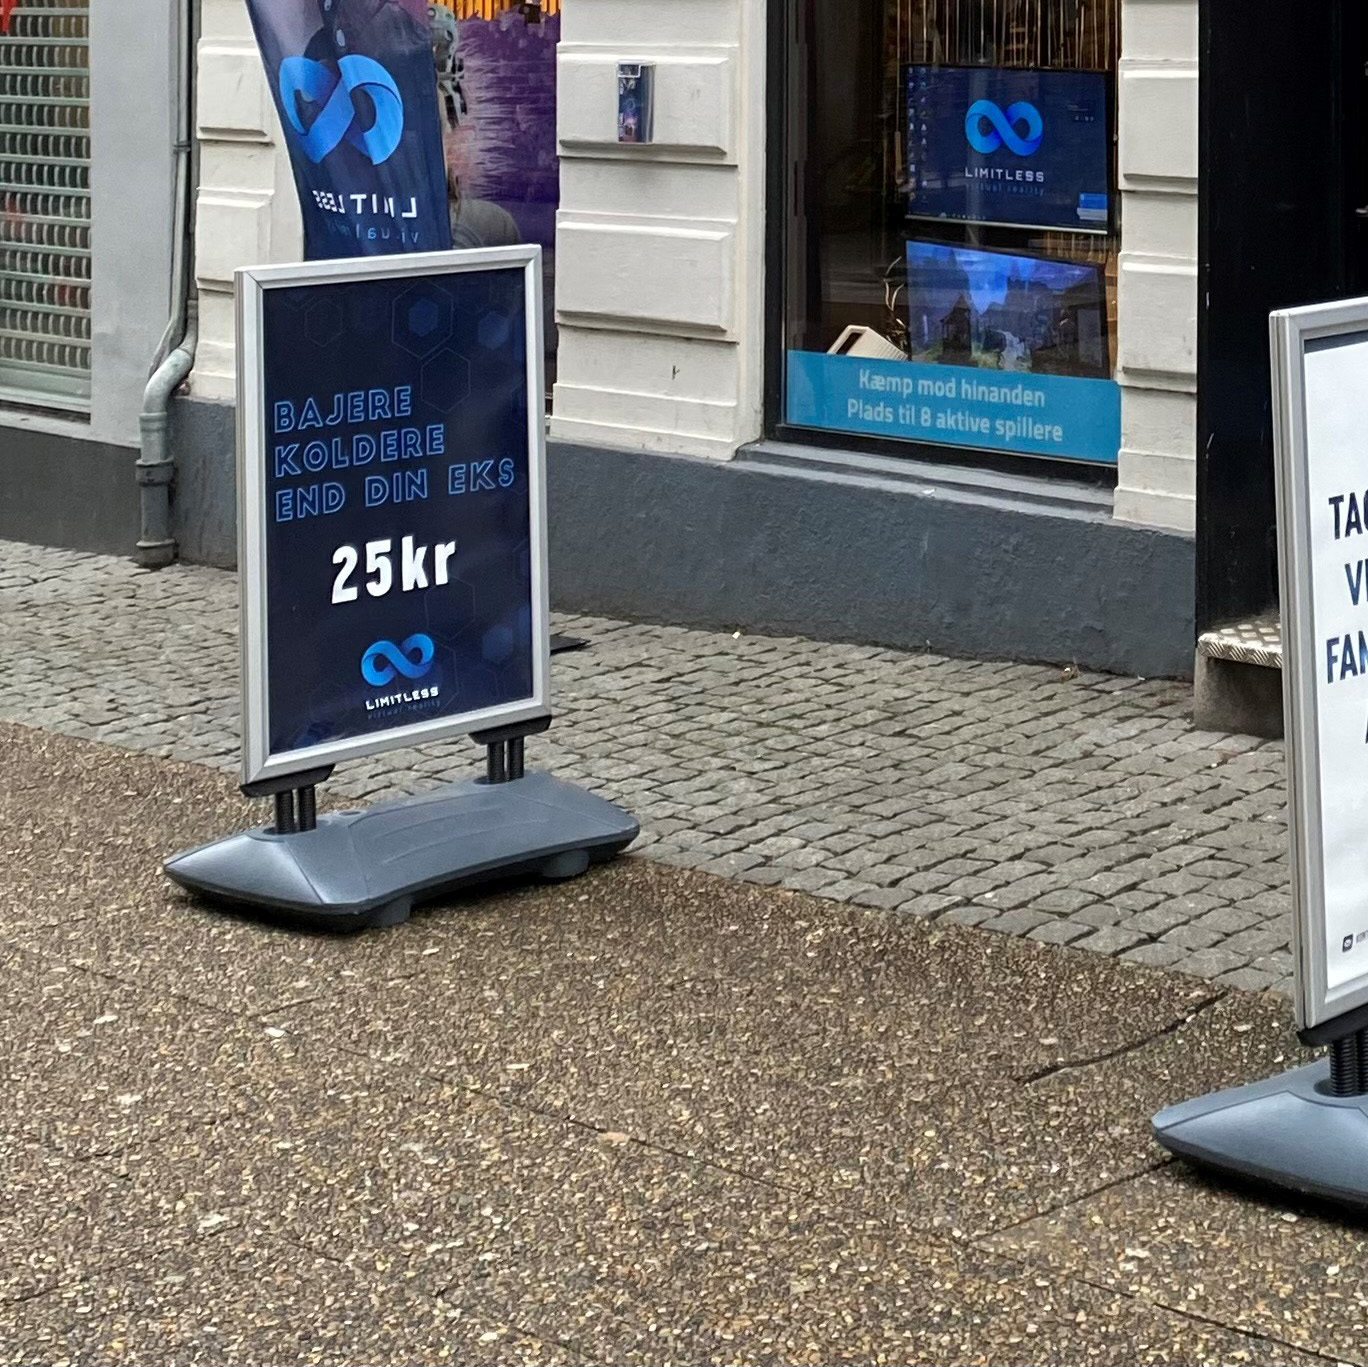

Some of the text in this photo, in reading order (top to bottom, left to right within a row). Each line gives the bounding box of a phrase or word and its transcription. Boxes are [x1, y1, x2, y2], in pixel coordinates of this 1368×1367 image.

[965, 167, 1044, 182] LIMITLESS
[274, 386, 412, 433] BAJERE
[859, 369, 1045, 407] Kæmp mod hinanden
[848, 398, 1063, 442] Plads til 8 aktive spillere
[275, 424, 445, 477] KOLDERE
[276, 458, 515, 522] END DIN EKS
[332, 535, 456, 604] 25kr
[365, 686, 439, 710] LIMITLESS
